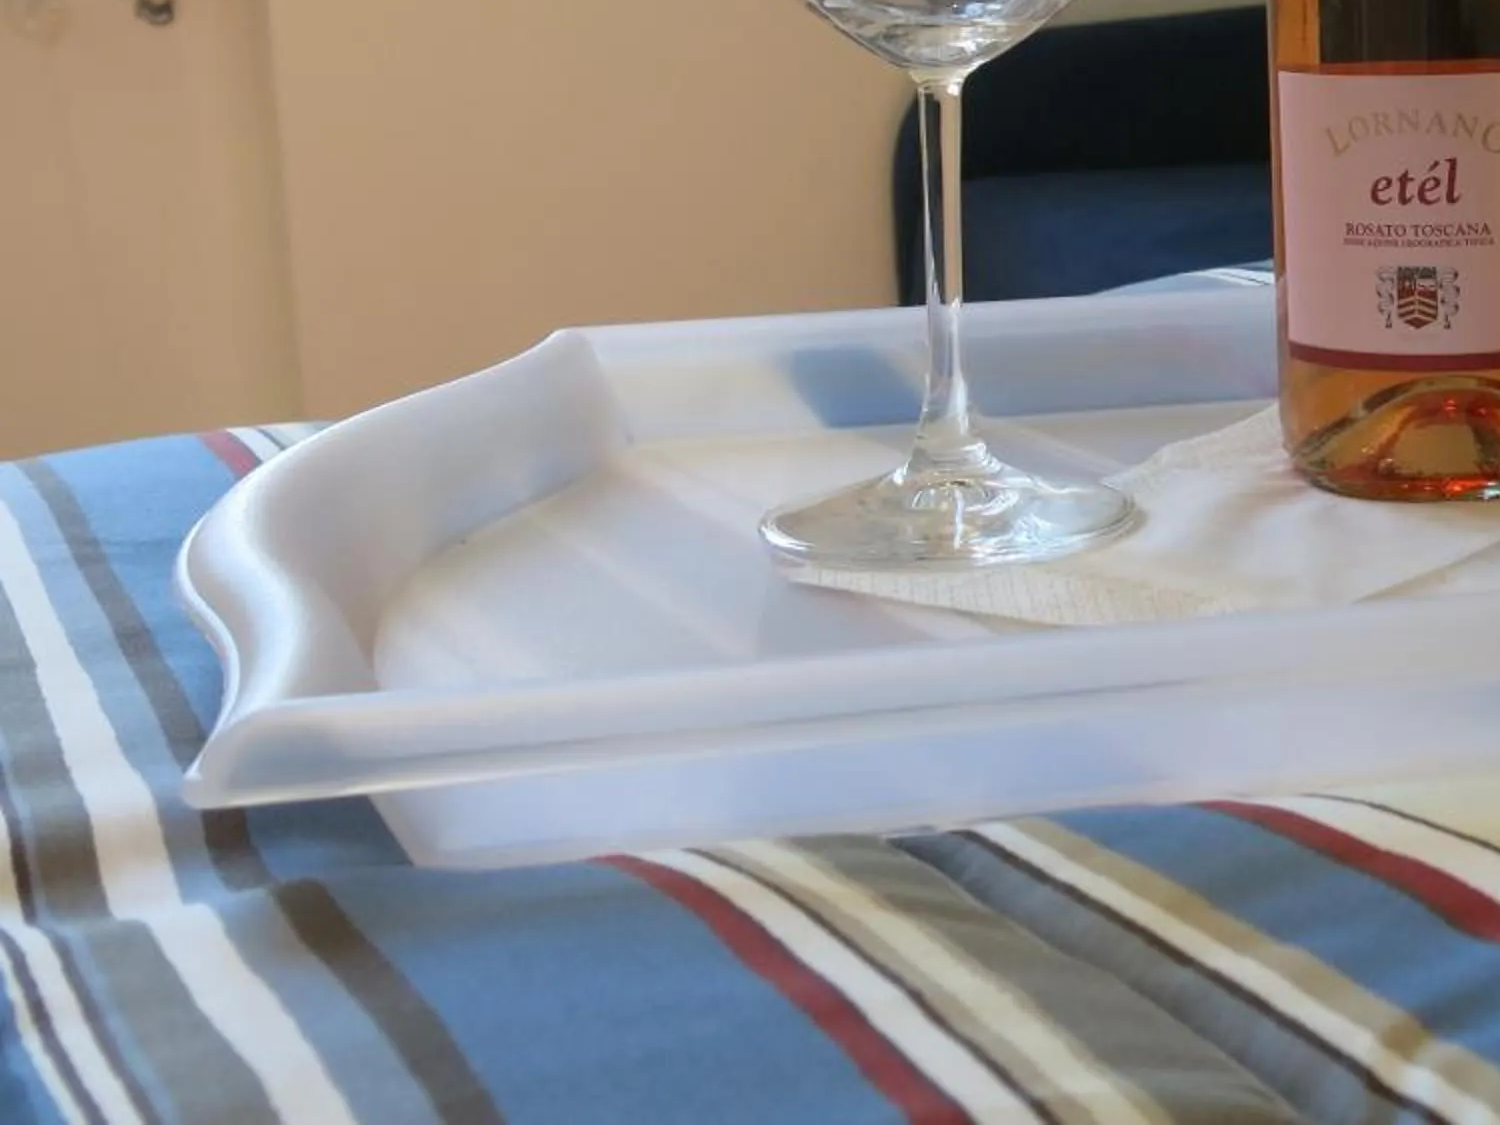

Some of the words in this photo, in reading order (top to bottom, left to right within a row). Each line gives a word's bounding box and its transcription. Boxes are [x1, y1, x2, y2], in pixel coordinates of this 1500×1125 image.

[1370, 157, 1462, 206] etél
[1345, 222, 1407, 237] ROSATO
[1410, 222, 1492, 237] TOSCANA
